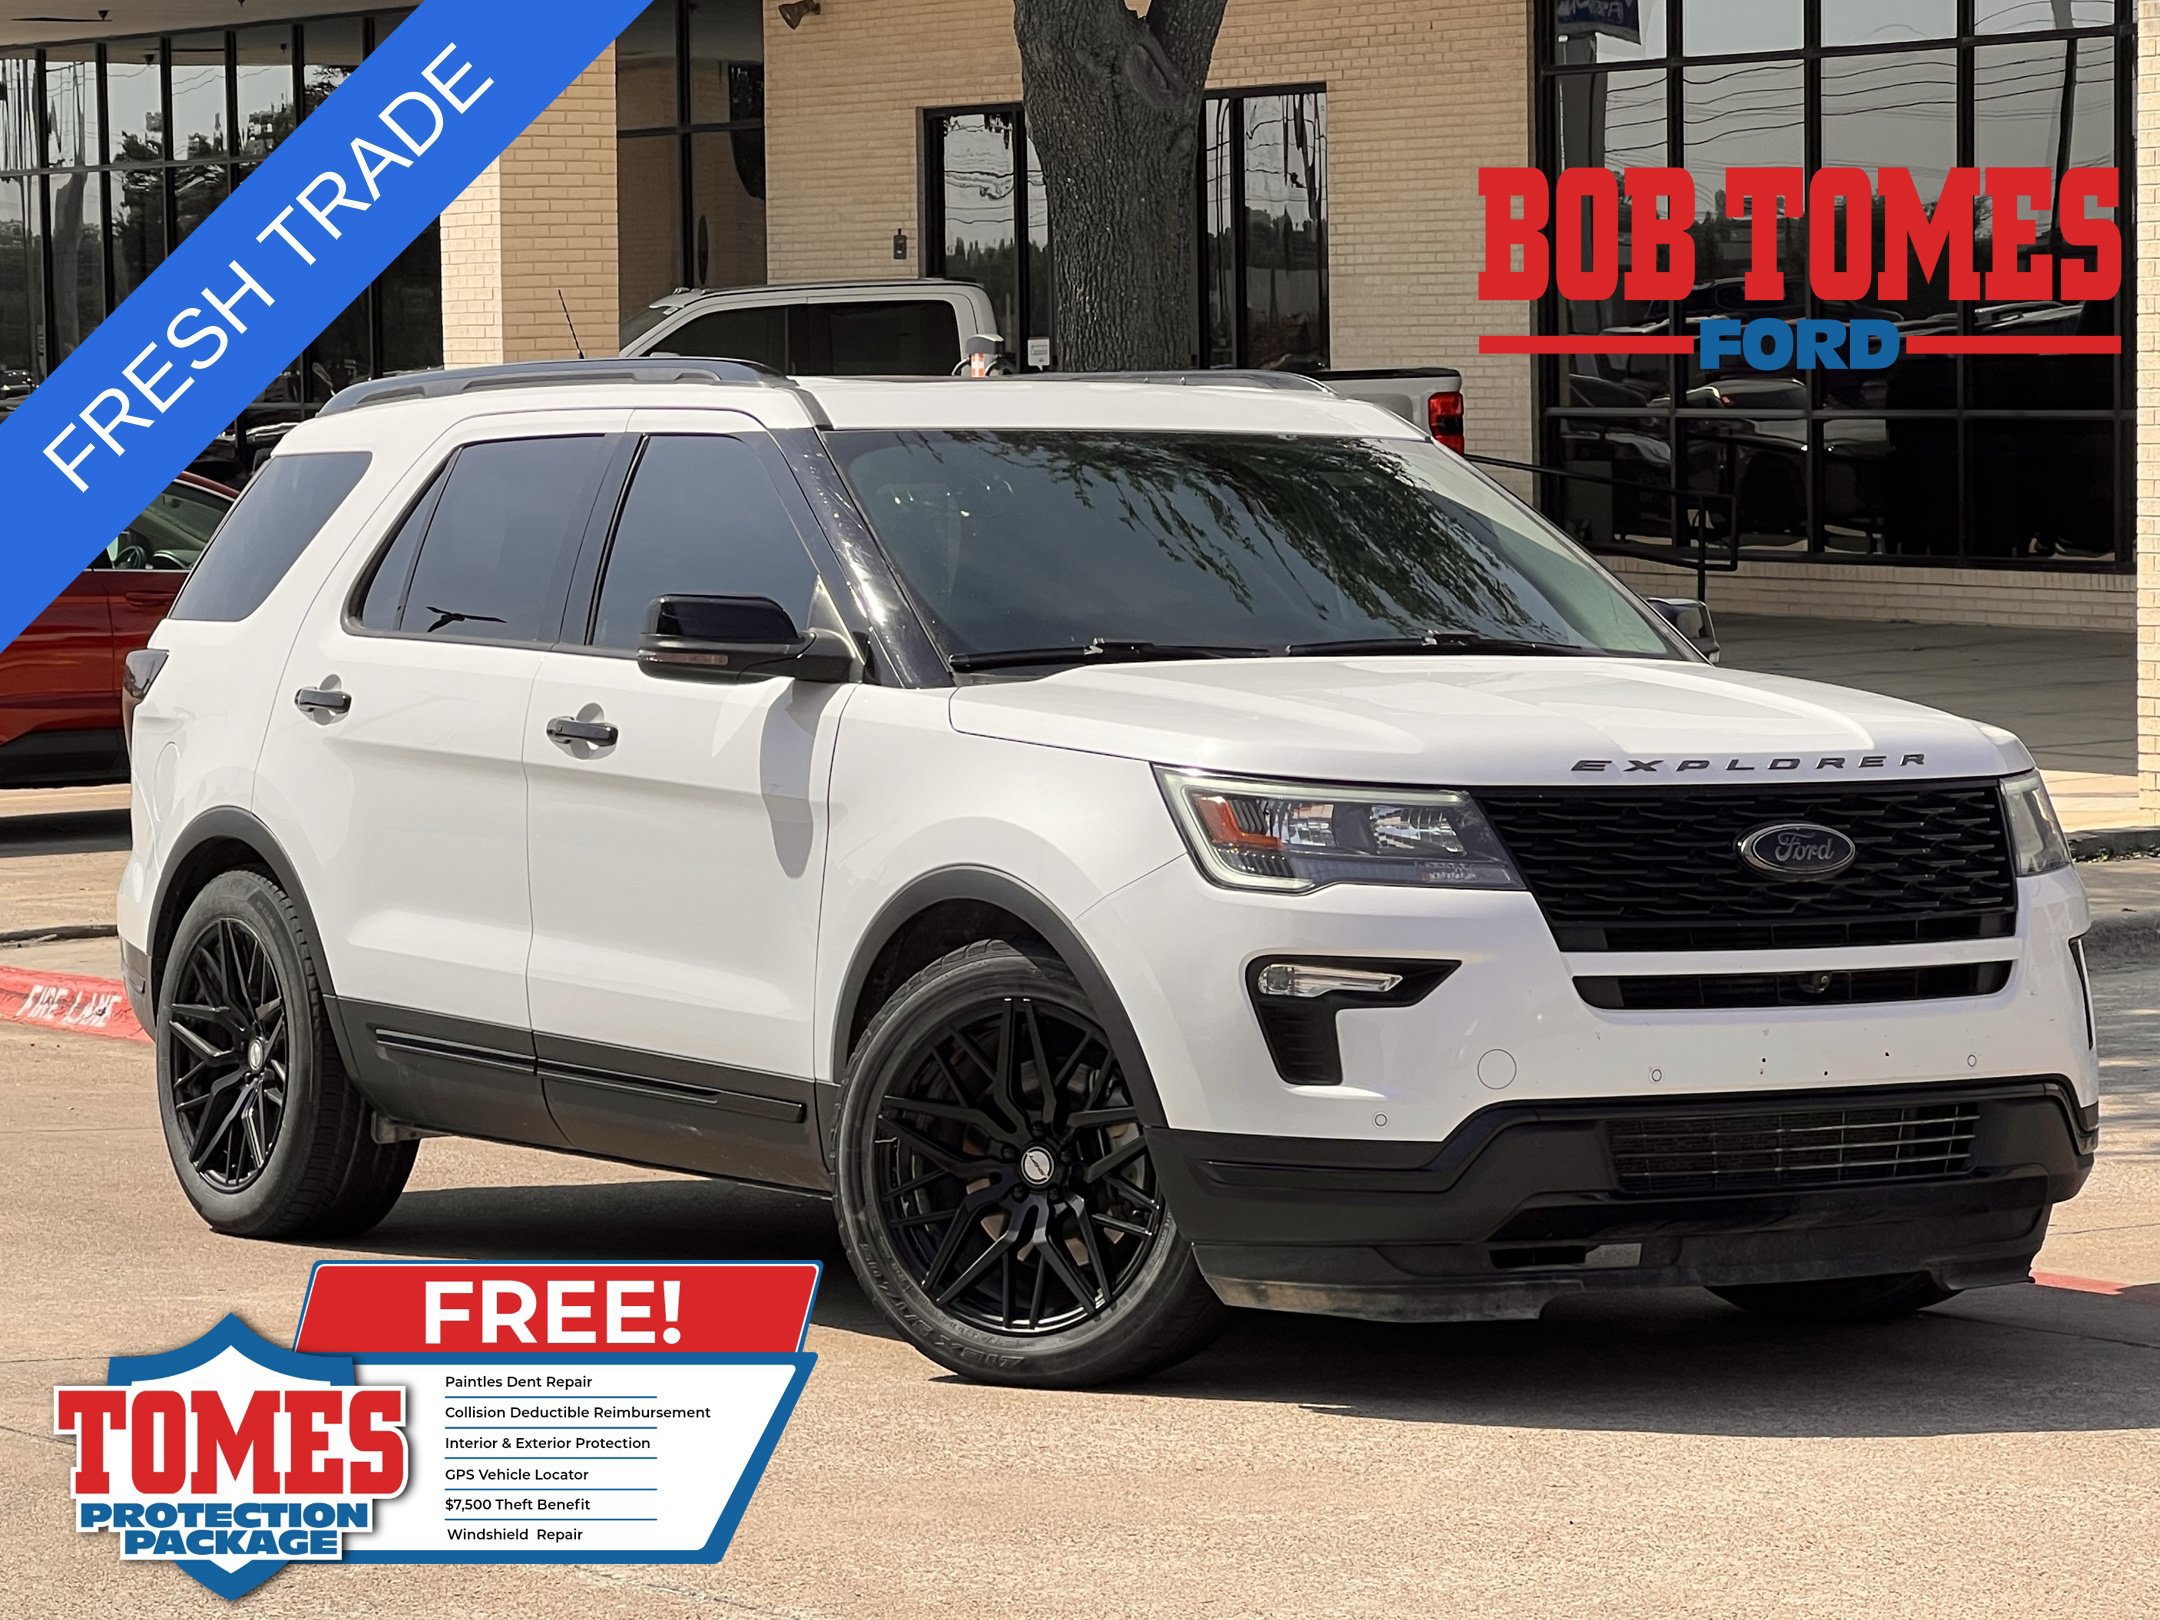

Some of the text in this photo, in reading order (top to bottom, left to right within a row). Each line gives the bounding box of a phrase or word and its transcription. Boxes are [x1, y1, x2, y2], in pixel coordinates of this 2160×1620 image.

[1570, 753, 1926, 772] EXPLORER
[1774, 831, 1834, 861] Ford
[15, 984, 69, 1019] FIRE
